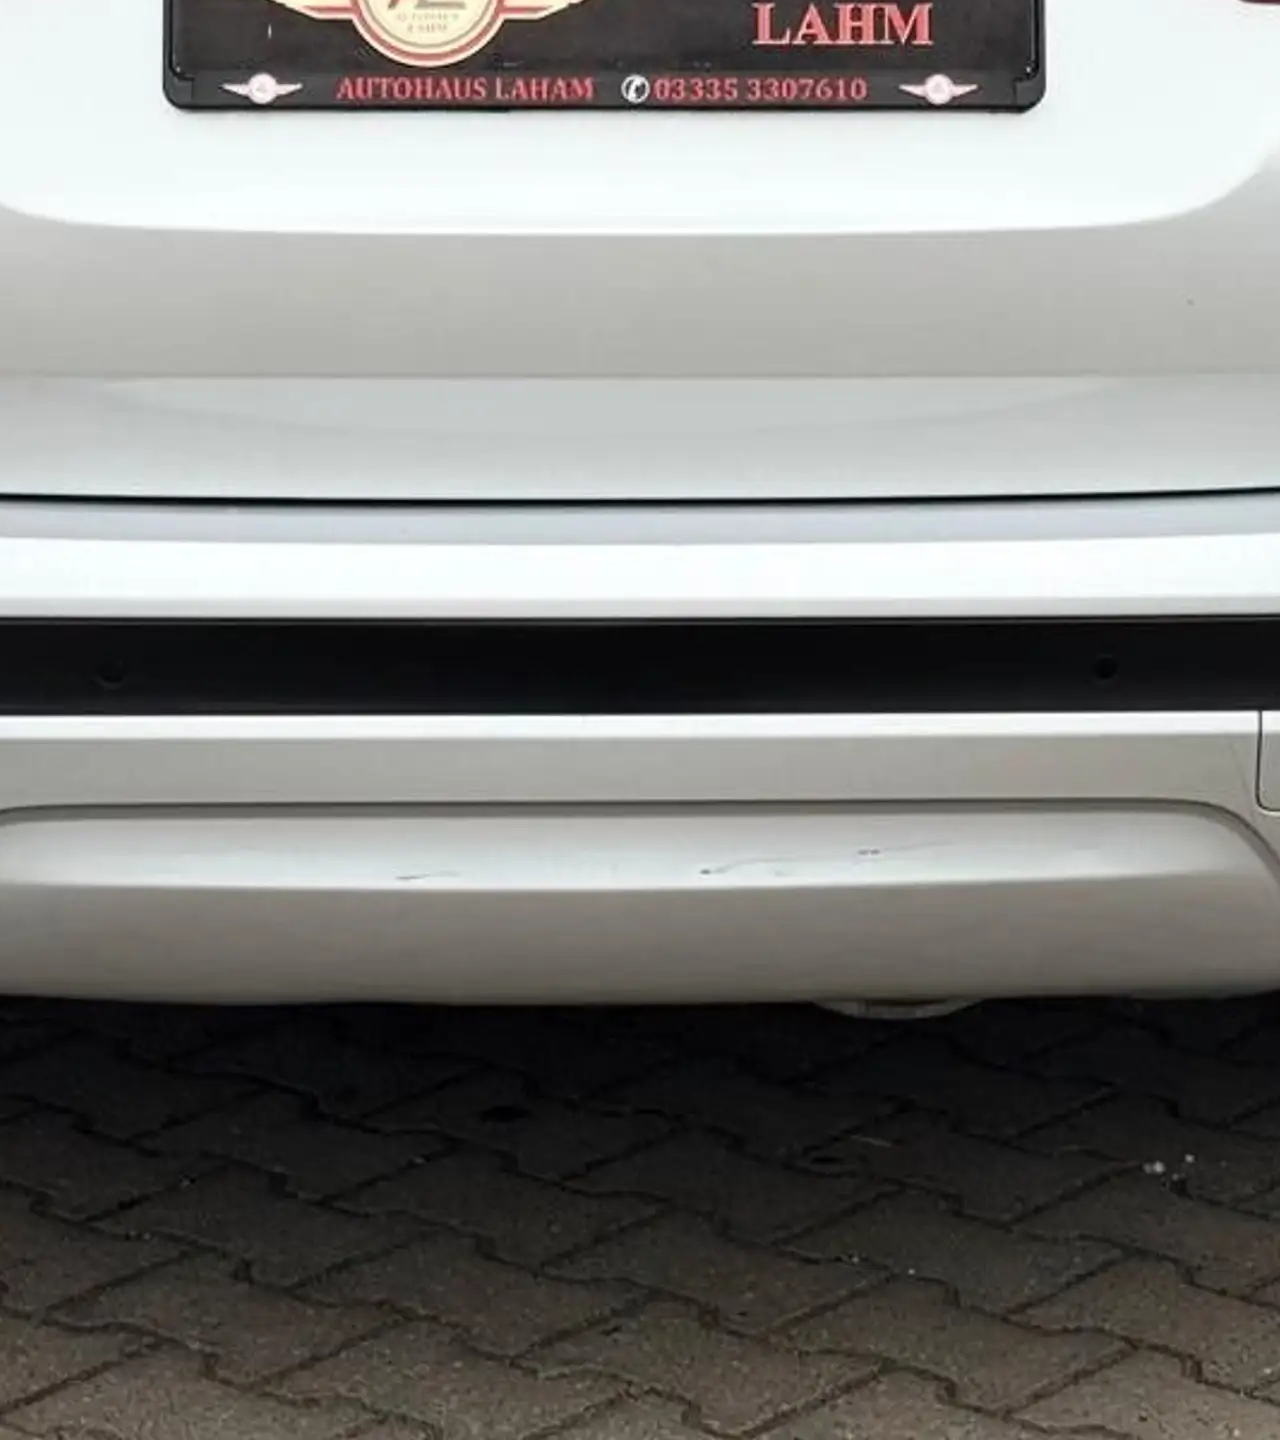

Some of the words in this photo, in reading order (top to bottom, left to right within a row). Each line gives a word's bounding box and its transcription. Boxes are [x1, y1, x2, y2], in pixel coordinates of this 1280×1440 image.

[751, 2, 934, 46] LAHM
[336, 76, 488, 101] AUTOHAUS
[495, 76, 595, 101] LAHAM
[746, 77, 868, 101] 3307610
